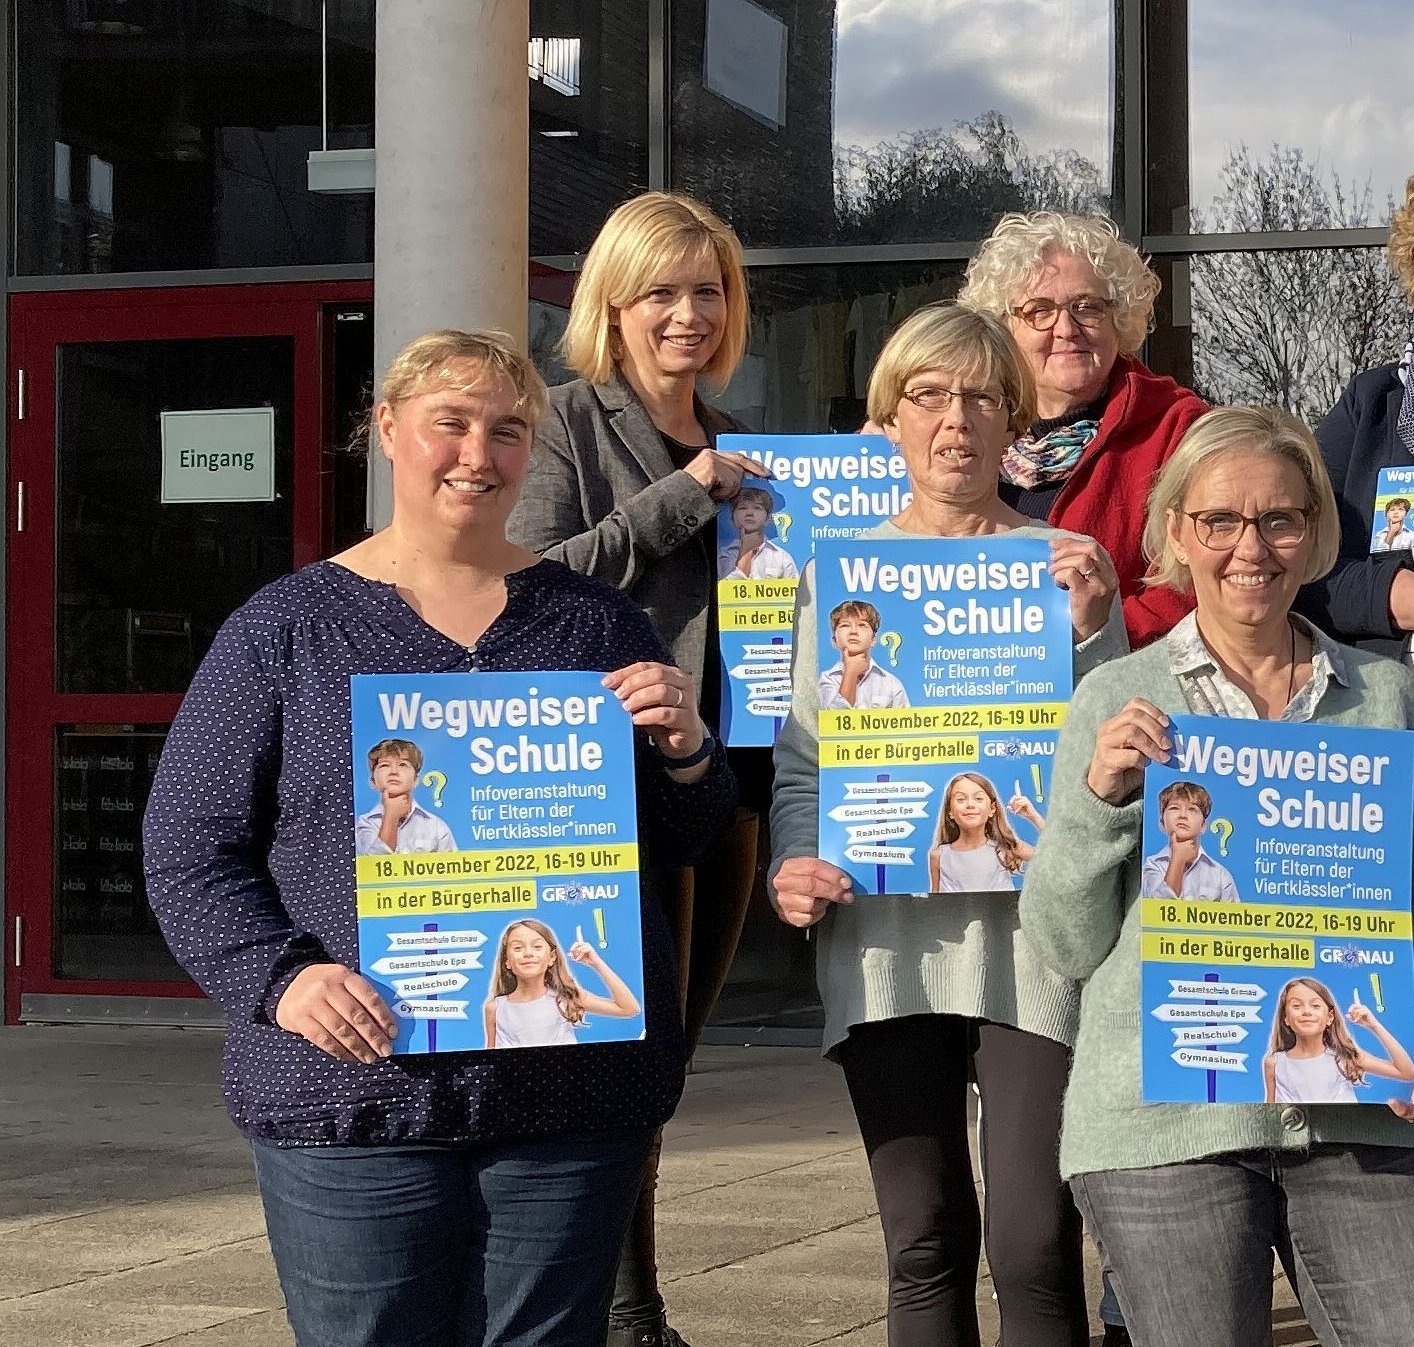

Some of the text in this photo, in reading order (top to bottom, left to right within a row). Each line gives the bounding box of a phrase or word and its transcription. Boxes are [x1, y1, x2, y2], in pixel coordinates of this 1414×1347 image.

[180, 449, 254, 472] Eingang
[738, 447, 907, 488] Wegweise
[840, 553, 1045, 600] Wegweiser
[733, 585, 751, 598] 18.
[734, 611, 747, 624] in
[751, 612, 774, 624] der
[924, 599, 1043, 635] Schule
[924, 644, 1045, 660] Infoveranstaltung
[924, 663, 1016, 679] für Eltern der
[379, 687, 605, 737] Wegweiser
[836, 709, 1057, 730] 18. November 2022, 16-19 Uhr
[471, 735, 603, 774] Schule
[837, 741, 974, 760] in der Bürgerhalle
[1174, 733, 1390, 786] Wegweiser
[472, 783, 606, 801] Infoveranstaltung
[471, 803, 574, 820] für Eltern der
[1257, 788, 1383, 832] Schule
[1256, 839, 1384, 864] Infoveranstaltung
[375, 851, 620, 877] 18. November 2022, 16-19 Uhr
[1255, 858, 1353, 878] für Eltern der
[377, 886, 531, 909] in der Bürgerhalle
[1160, 906, 1395, 932] 18. November 2022, 16-19 Uhr
[1161, 937, 1309, 960] in der Bürgerhalle
